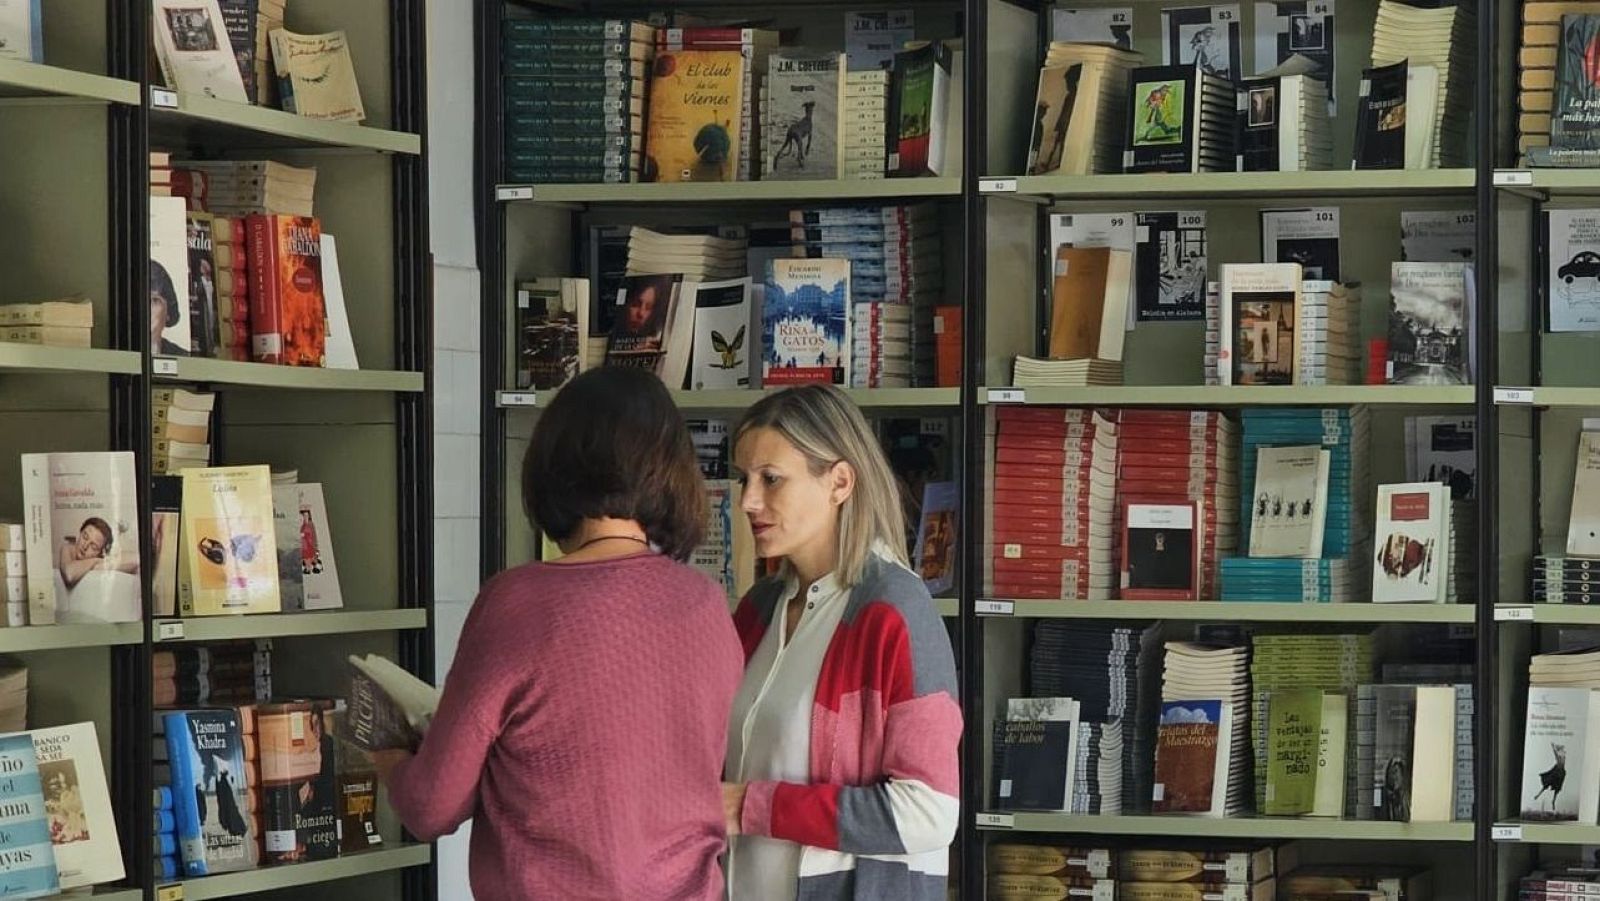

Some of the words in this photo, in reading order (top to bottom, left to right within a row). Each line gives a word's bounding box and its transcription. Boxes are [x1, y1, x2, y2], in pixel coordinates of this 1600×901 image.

[1218, 10, 1233, 20] 83
[1314, 4, 1328, 14] 84
[1112, 13, 1126, 22] 82
[686, 63, 700, 77] El
[702, 61, 732, 78] club
[683, 91, 732, 107] Viernes
[1110, 217, 1124, 227] 99
[1182, 216, 1201, 225] 100
[1316, 212, 1334, 221] 101
[1456, 214, 1475, 224] 102
[780, 322, 809, 336] RIÑA
[782, 336, 826, 348] GATOS
[191, 719, 227, 734] Yasmina
[196, 733, 227, 750] Khadra
[0, 802, 31, 818] ma
[294, 813, 335, 830] Romance
[312, 831, 336, 848] ciego
